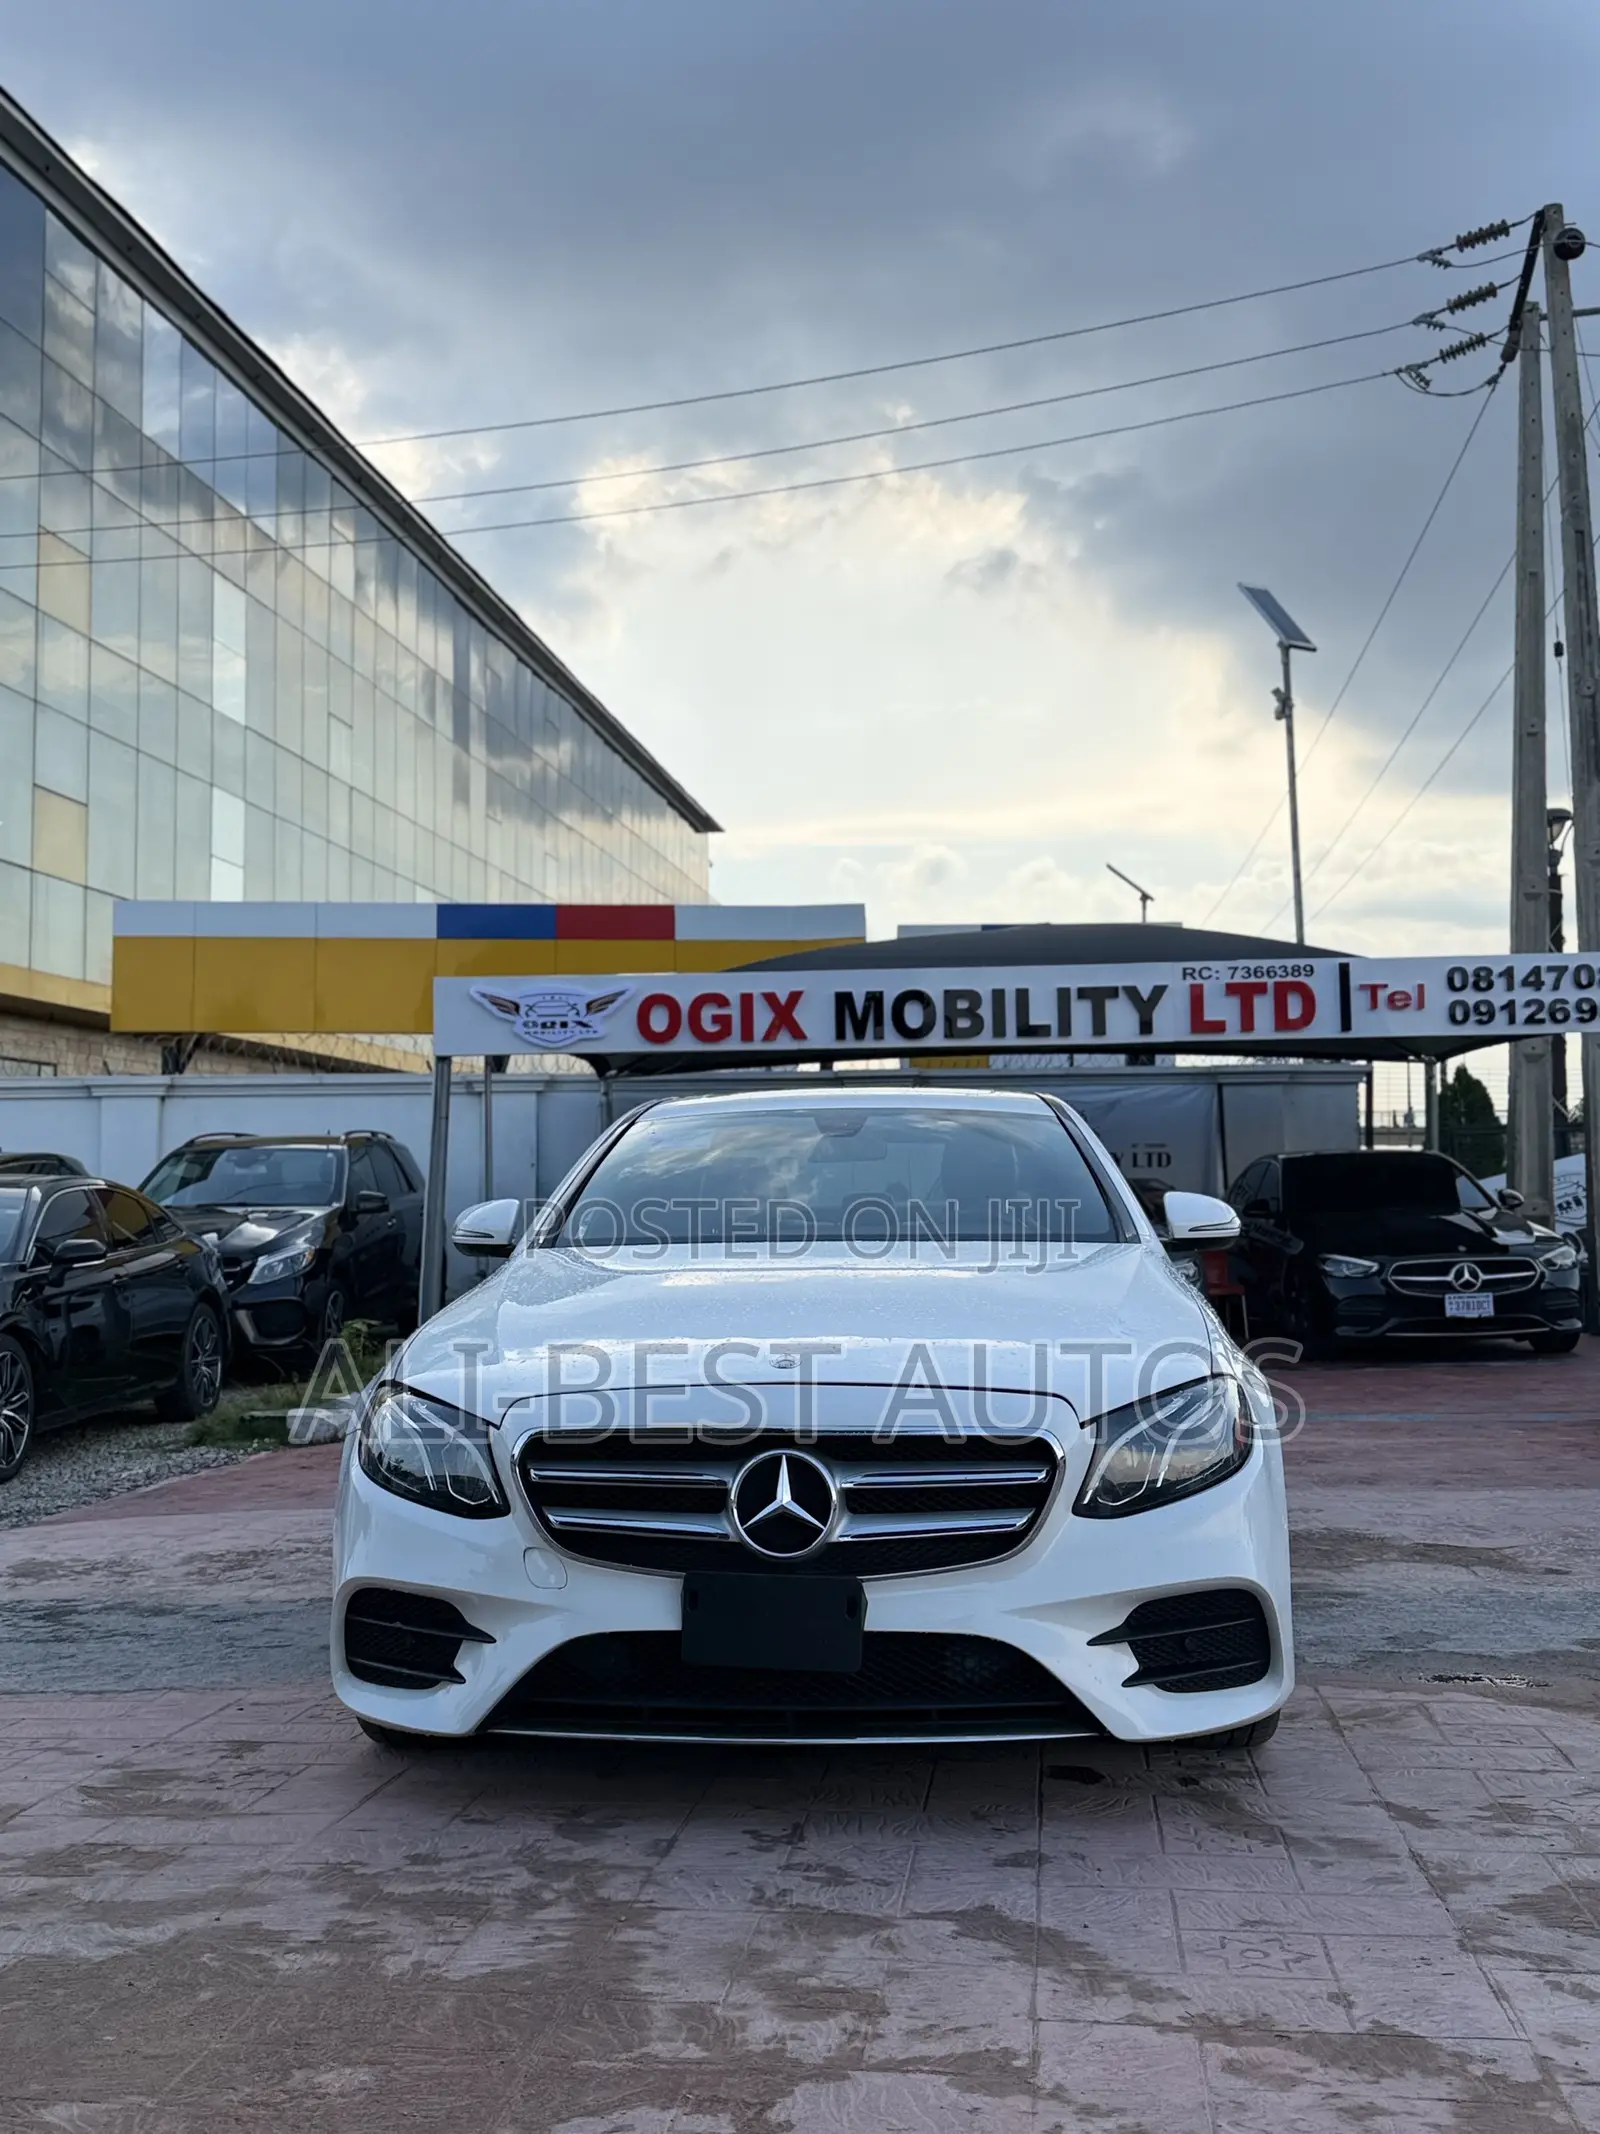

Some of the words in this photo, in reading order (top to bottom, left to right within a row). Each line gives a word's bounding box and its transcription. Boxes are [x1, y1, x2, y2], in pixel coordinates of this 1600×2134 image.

[1181, 966, 1220, 981] RC:
[1227, 964, 1315, 980] 7366389
[1446, 963, 1600, 994] 081470
[1359, 983, 1426, 1012] Tel
[1448, 997, 1598, 1026] 091269
[636, 987, 806, 1044] OGIX
[834, 983, 1169, 1041] MOBILITY
[1188, 981, 1317, 1034] LTD
[1132, 1151, 1172, 1168] LTD
